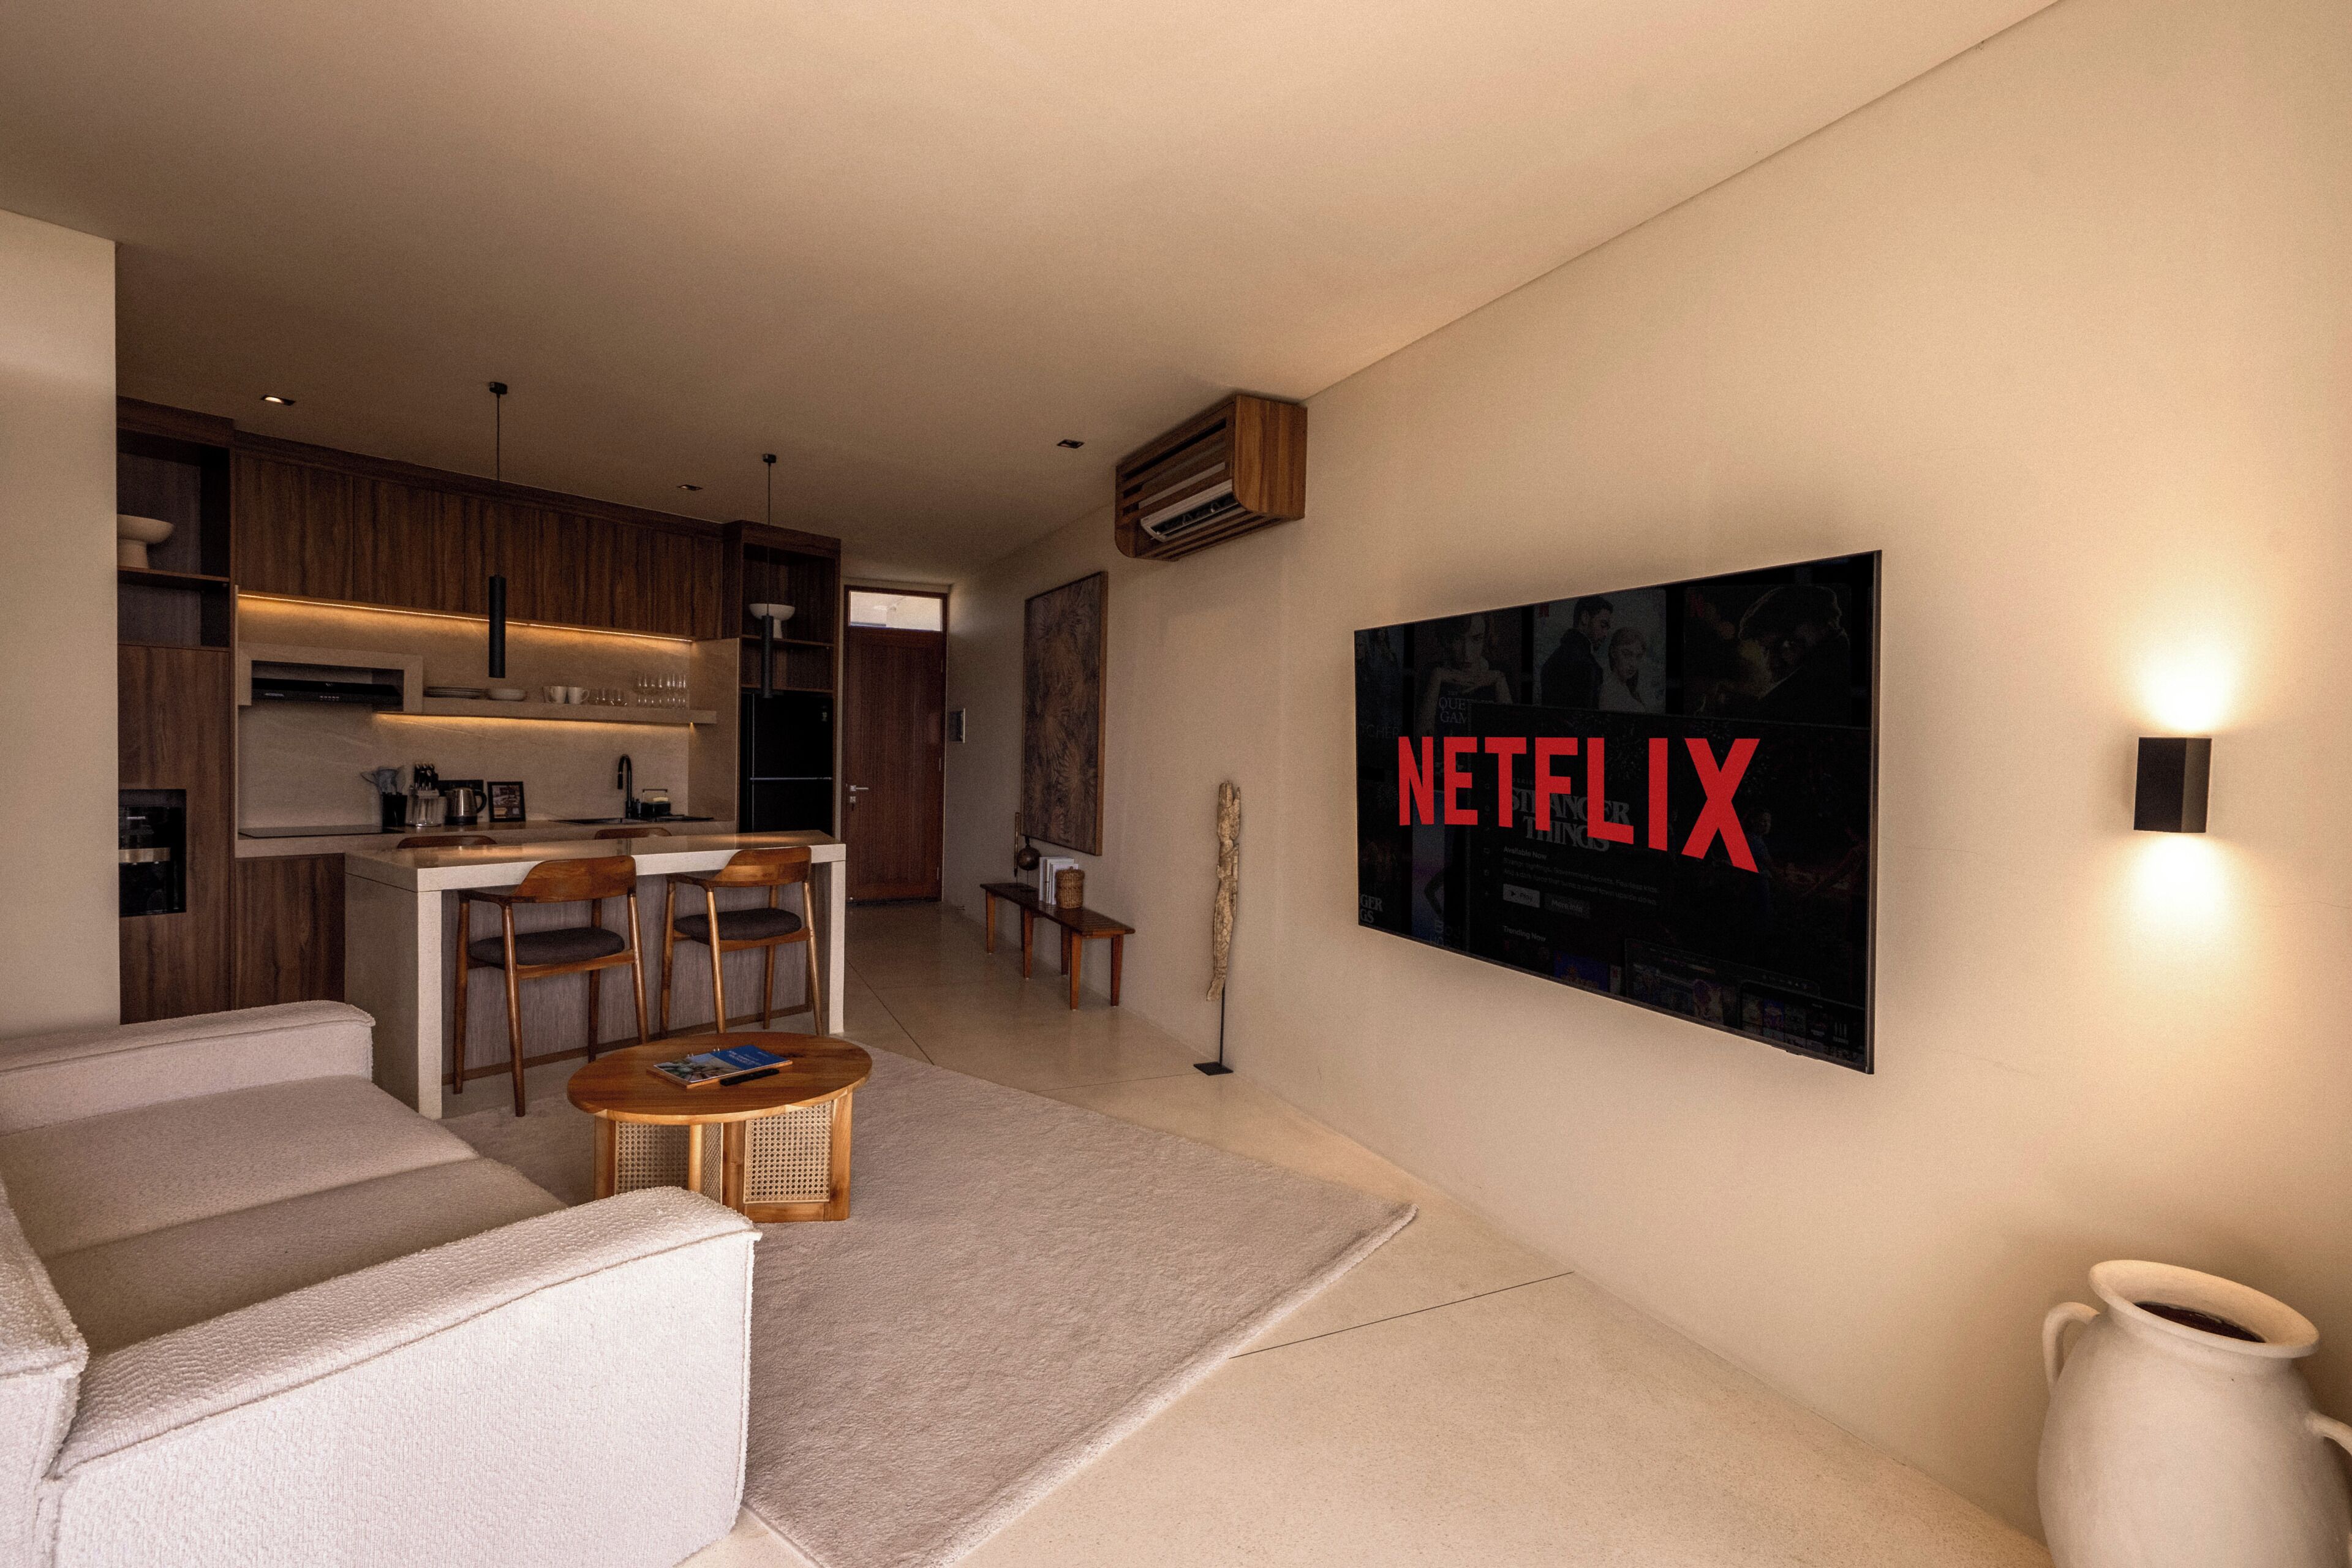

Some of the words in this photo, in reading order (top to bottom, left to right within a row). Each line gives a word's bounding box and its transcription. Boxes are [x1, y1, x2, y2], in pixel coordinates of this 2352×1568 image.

[1439, 696, 1466, 711] QUE
[1398, 736, 1761, 873] NETFLIX
[1532, 850, 1547, 861] Now
[1520, 892, 1534, 902] Play
[1551, 899, 1569, 909] More
[1502, 925, 1531, 940] Trending
[1531, 932, 1547, 943] Now
